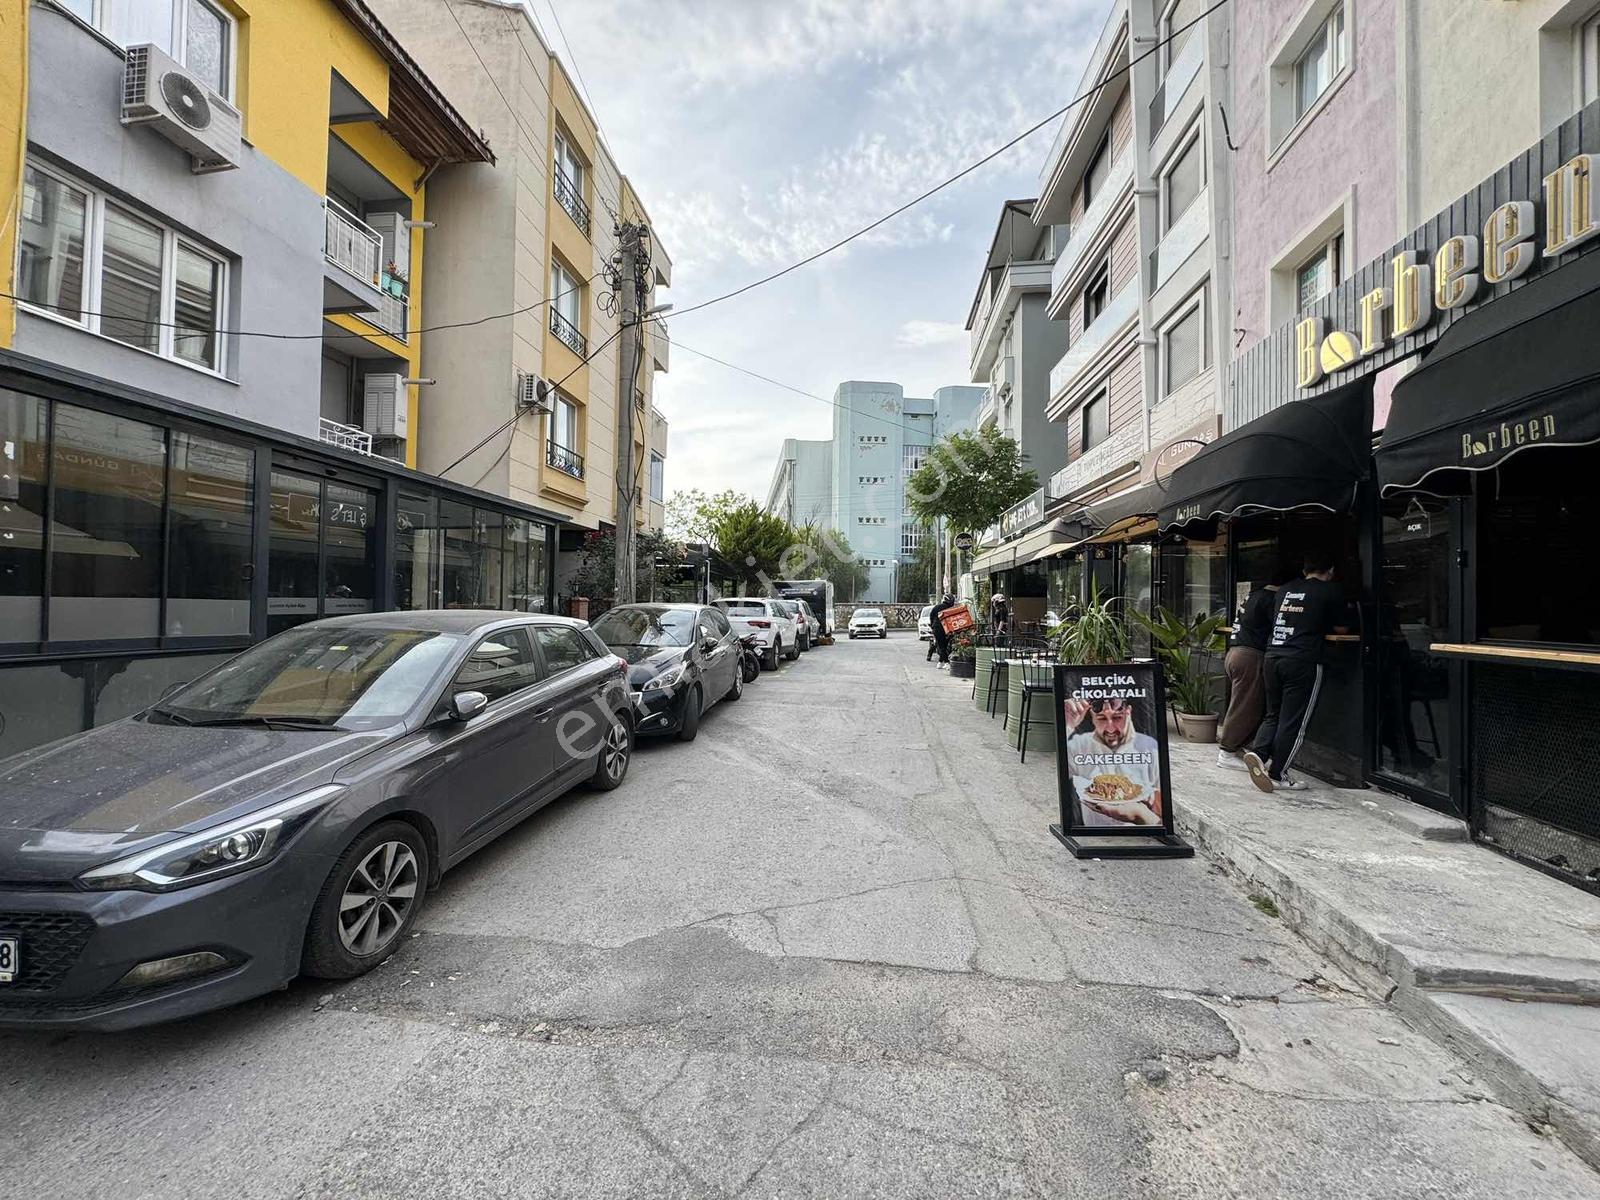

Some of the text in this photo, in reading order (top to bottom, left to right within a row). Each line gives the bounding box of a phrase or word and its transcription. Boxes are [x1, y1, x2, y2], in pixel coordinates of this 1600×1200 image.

[1081, 673, 1135, 688] BELÇİKA
[1071, 688, 1146, 702] ÇİKOLATALI
[1073, 752, 1152, 766] CAKEBEEN
